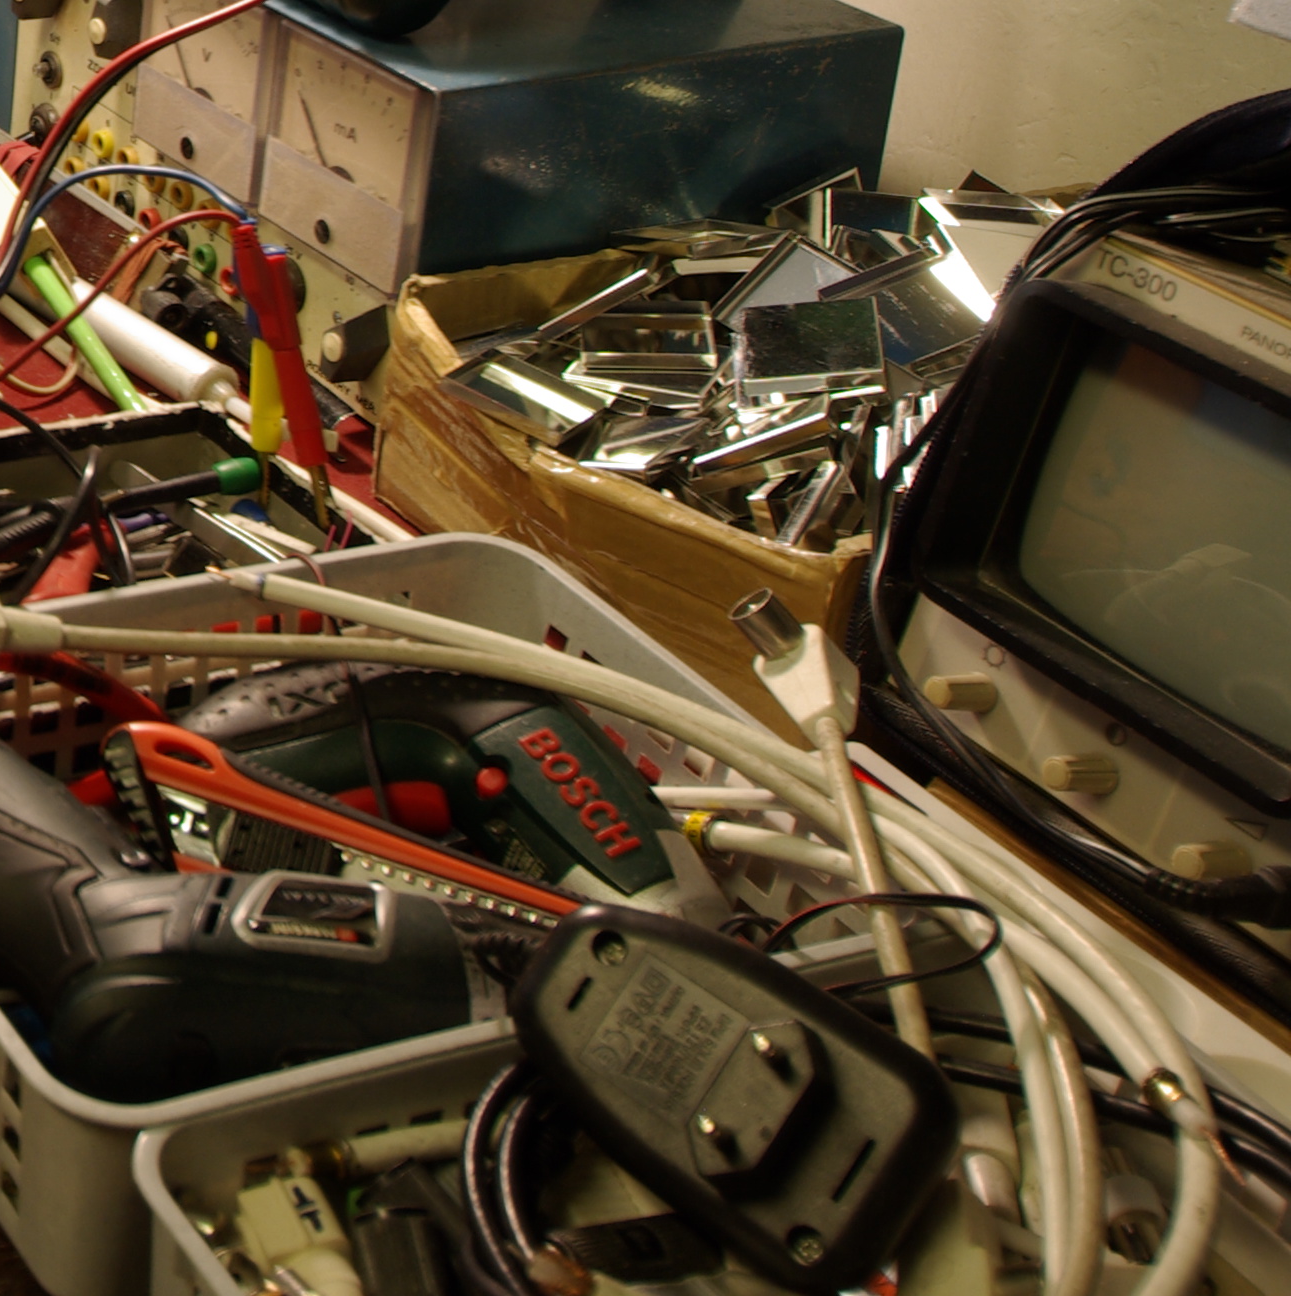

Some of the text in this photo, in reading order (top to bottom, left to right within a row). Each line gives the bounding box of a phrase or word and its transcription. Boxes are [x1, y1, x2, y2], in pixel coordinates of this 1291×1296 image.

[333, 122, 357, 144] mA
[1097, 247, 1179, 302] TC-300
[517, 726, 643, 861] BOSCH
